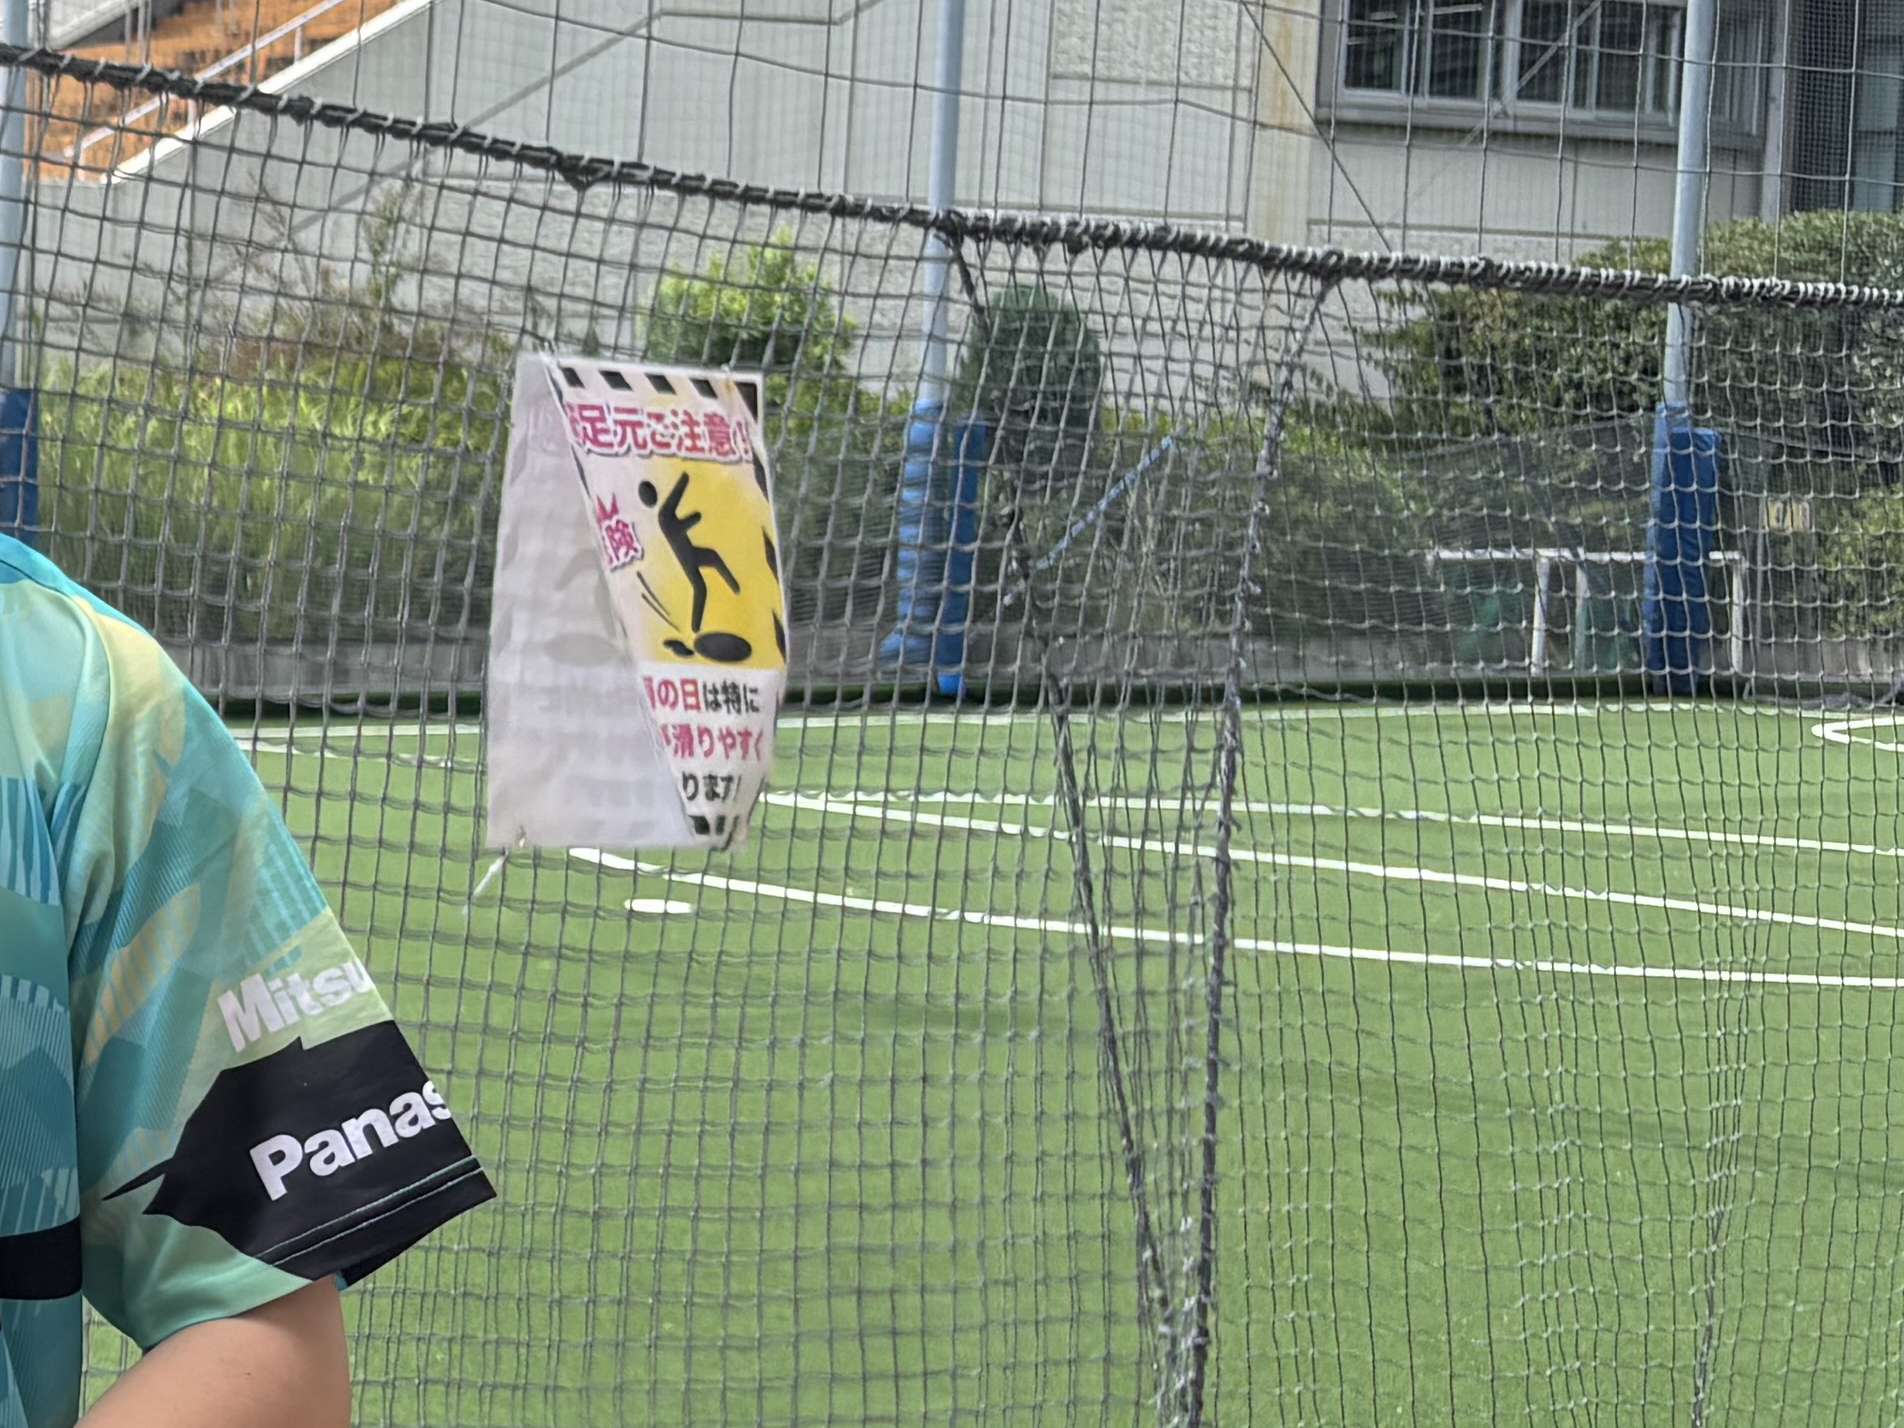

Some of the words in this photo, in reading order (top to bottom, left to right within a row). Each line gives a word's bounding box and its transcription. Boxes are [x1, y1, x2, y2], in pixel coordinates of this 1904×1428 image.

[643, 675, 760, 715] の日は特に
